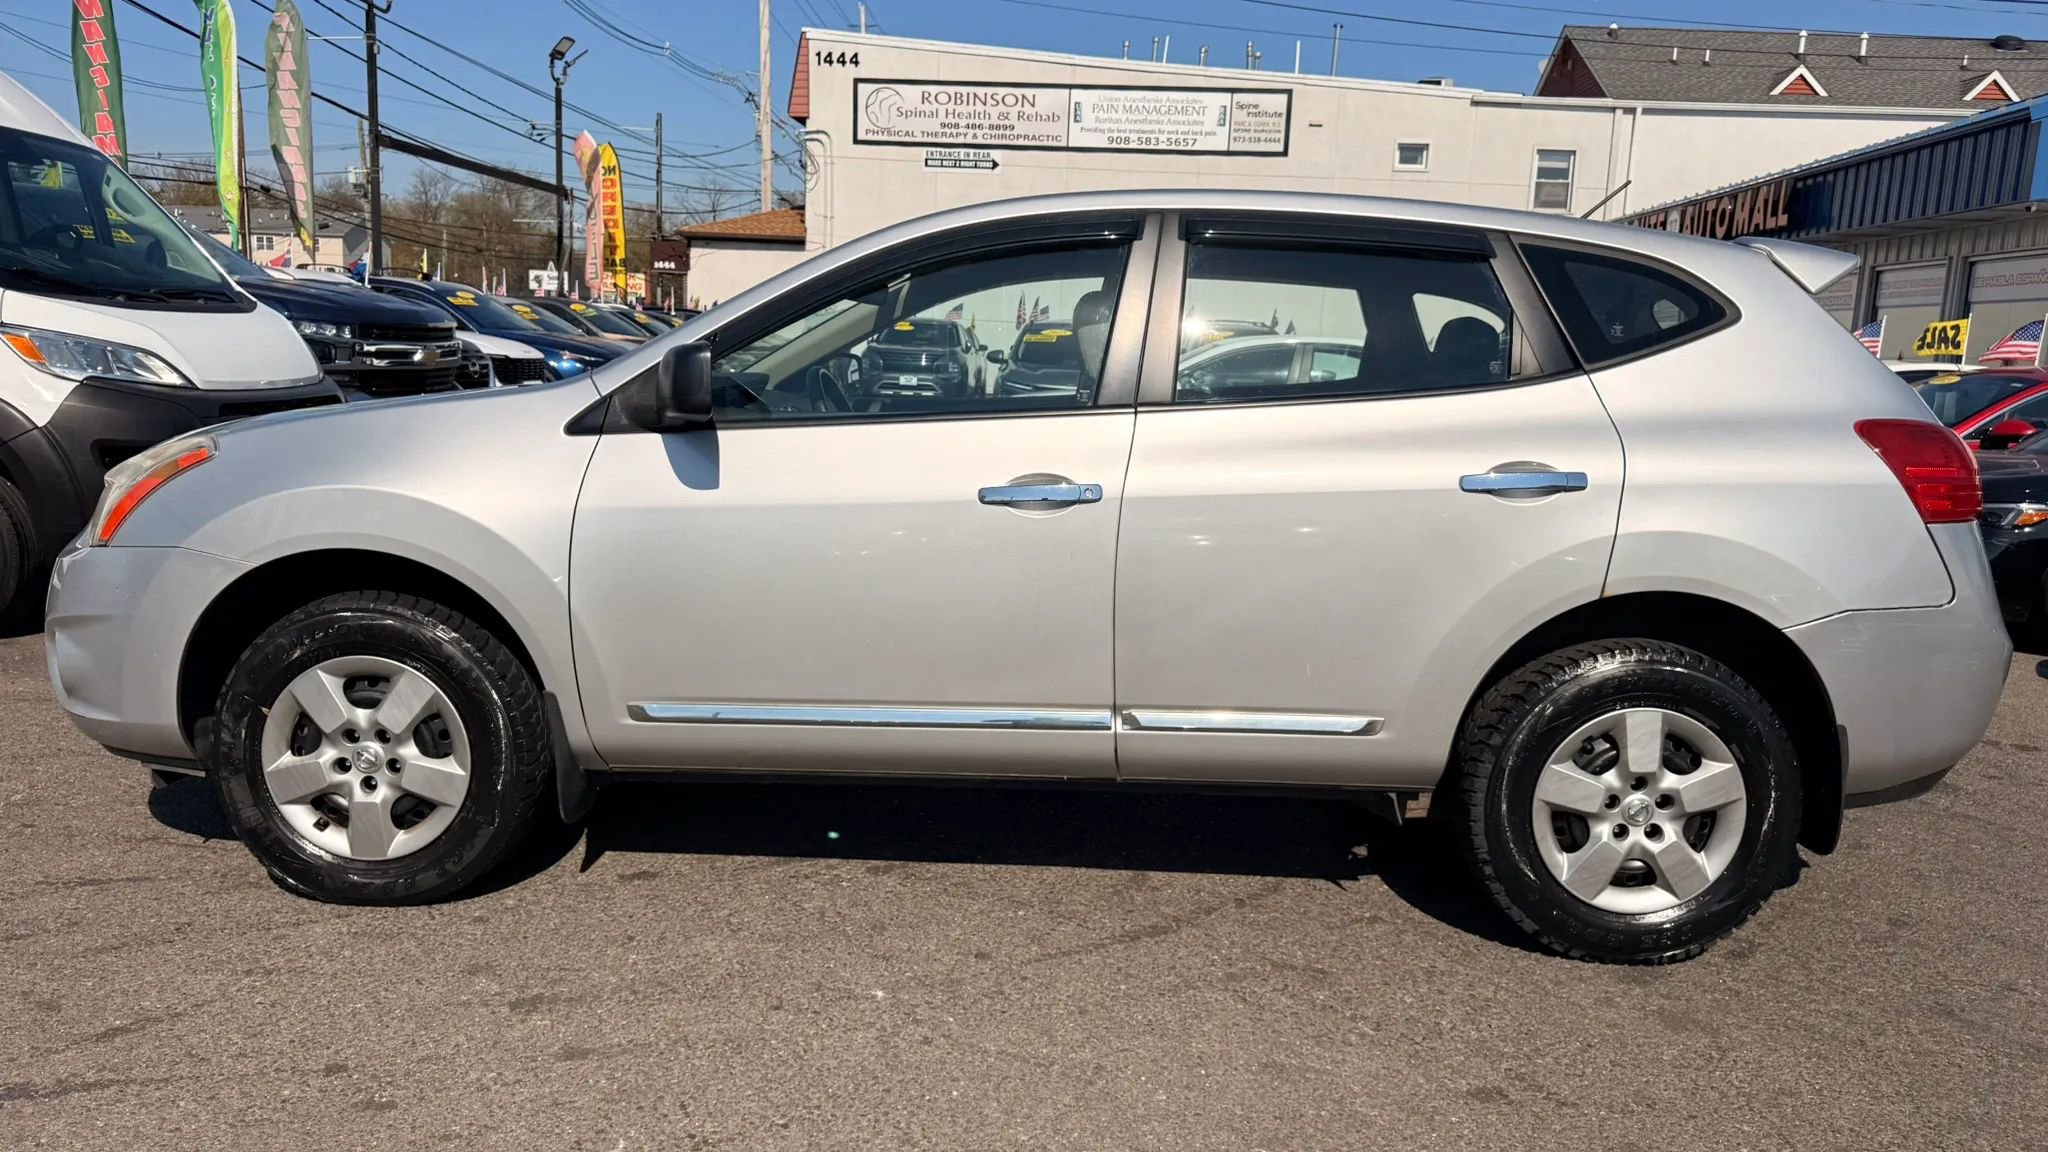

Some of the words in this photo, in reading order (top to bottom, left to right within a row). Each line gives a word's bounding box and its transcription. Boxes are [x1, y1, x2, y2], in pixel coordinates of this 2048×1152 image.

[815, 51, 860, 68] 1444
[921, 91, 1036, 108] ROBINSON
[1124, 95, 1164, 104] Anesthesia
[1165, 97, 1203, 105] Associates
[1092, 103, 1119, 114] PAIN
[1122, 105, 1208, 116] MANAGEMENT
[1235, 101, 1259, 112] Spine
[896, 106, 939, 120] Spinal
[945, 108, 991, 121] Health
[997, 111, 1011, 121] &
[1017, 109, 1060, 123] Rehab
[940, 122, 1015, 131] 908-486-8899
[1124, 117, 1165, 126] Anesthesia
[1166, 118, 1205, 127] Associates
[865, 129, 918, 138] PHYSICAL
[920, 131, 969, 140] THERAPY
[982, 133, 1063, 143] CHIROPRACTIC
[1080, 126, 1106, 135] Providing
[1107, 135, 1198, 147] 908-583-5657
[926, 150, 961, 158] ENTRANCE
[1682, 196, 1731, 239] AUTO
[1732, 180, 1790, 237] MALL
[1985, 274, 2014, 288] HABLA
[2014, 268, 2048, 286] ESPAÑ
